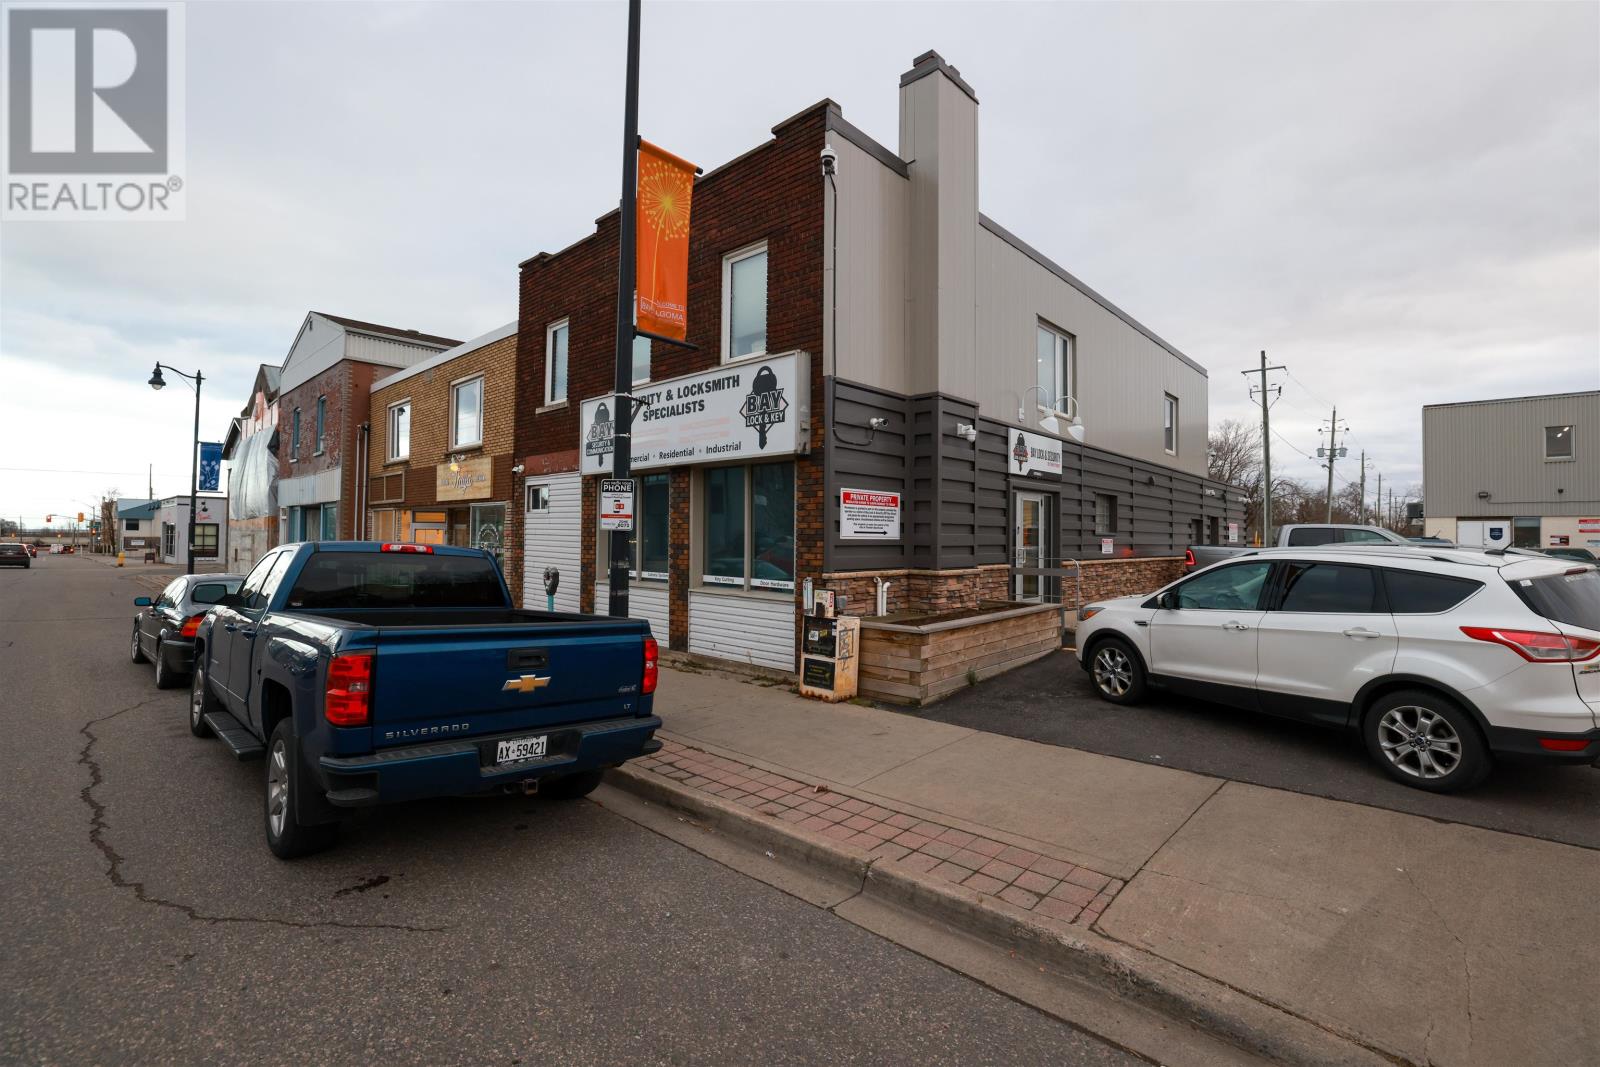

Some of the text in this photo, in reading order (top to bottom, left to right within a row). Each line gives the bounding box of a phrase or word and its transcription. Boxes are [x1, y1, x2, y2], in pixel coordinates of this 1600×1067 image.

[666, 389, 673, 402] &
[677, 375, 740, 399] LOCKSMITH
[643, 400, 705, 422] SPECIALISTS
[746, 390, 784, 414] BAY
[747, 410, 784, 425] LOCK & KEY
[591, 422, 614, 440] BAY
[630, 441, 742, 462] mercial Residential Industrial
[385, 723, 470, 739] SILVERADO
